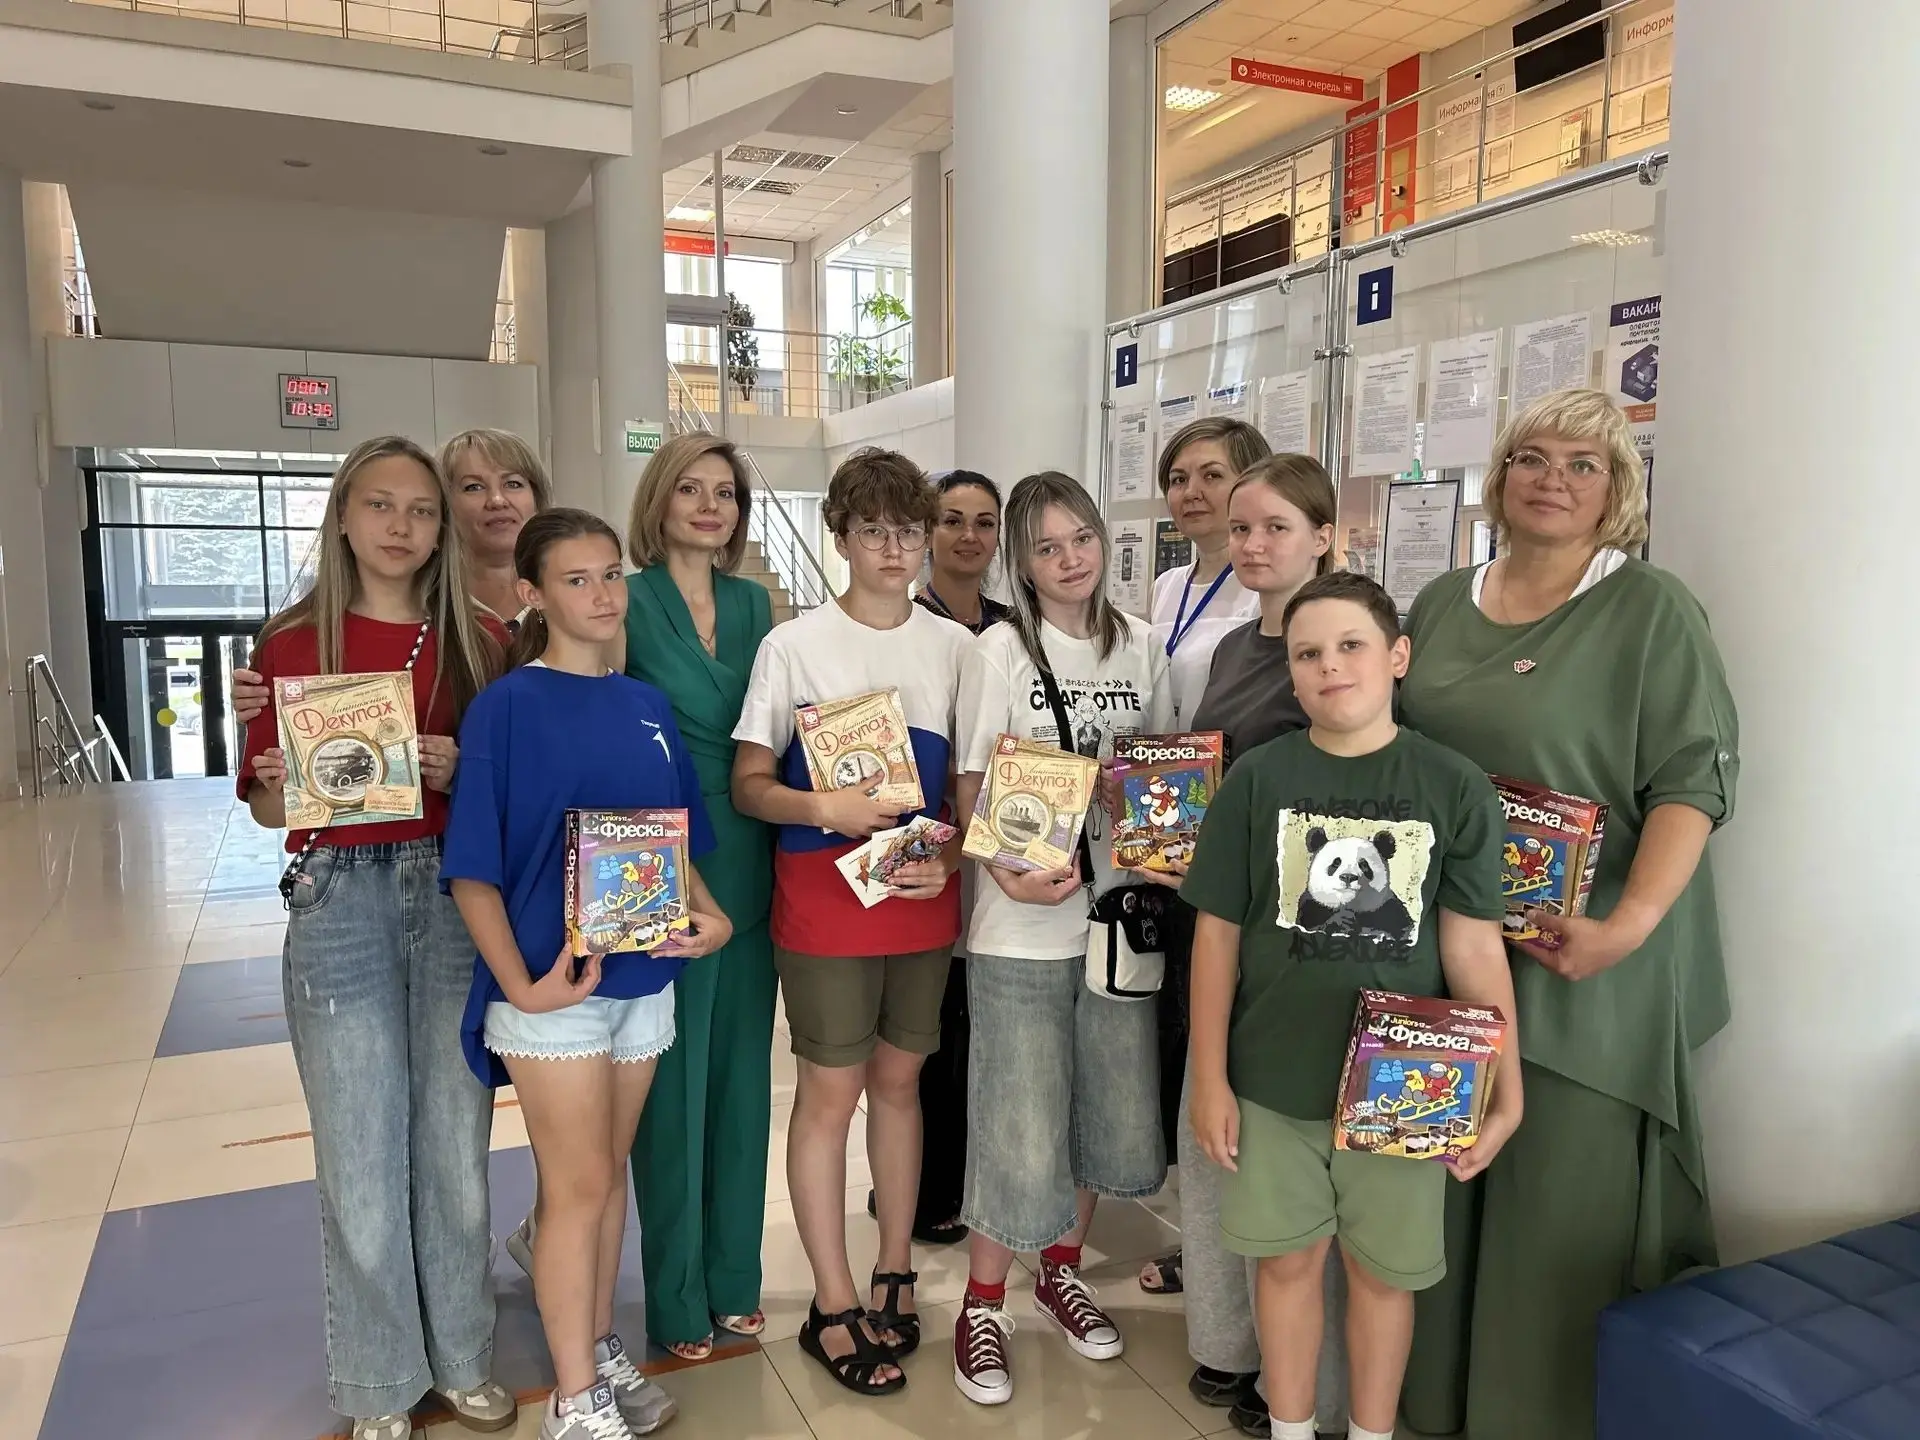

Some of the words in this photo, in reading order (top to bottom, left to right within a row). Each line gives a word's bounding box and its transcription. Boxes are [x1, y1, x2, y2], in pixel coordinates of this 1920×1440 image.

[1252, 68, 1305, 86] Электронная
[1307, 80, 1341, 92] очередь
[1622, 301, 1661, 319] ВАКАН
[291, 402, 333, 417] 10:35
[628, 436, 661, 453] ВЫХОД
[293, 700, 397, 739] Декупаж
[814, 713, 893, 757] Декупаж
[1132, 745, 1196, 765] Фреска
[999, 761, 1078, 790] Декупаж
[600, 821, 664, 842] Фреска
[567, 848, 576, 919] Фреска
[1541, 931, 1555, 943] 45
[1388, 1024, 1471, 1052] Фреска
[1447, 1146, 1461, 1157] 45
